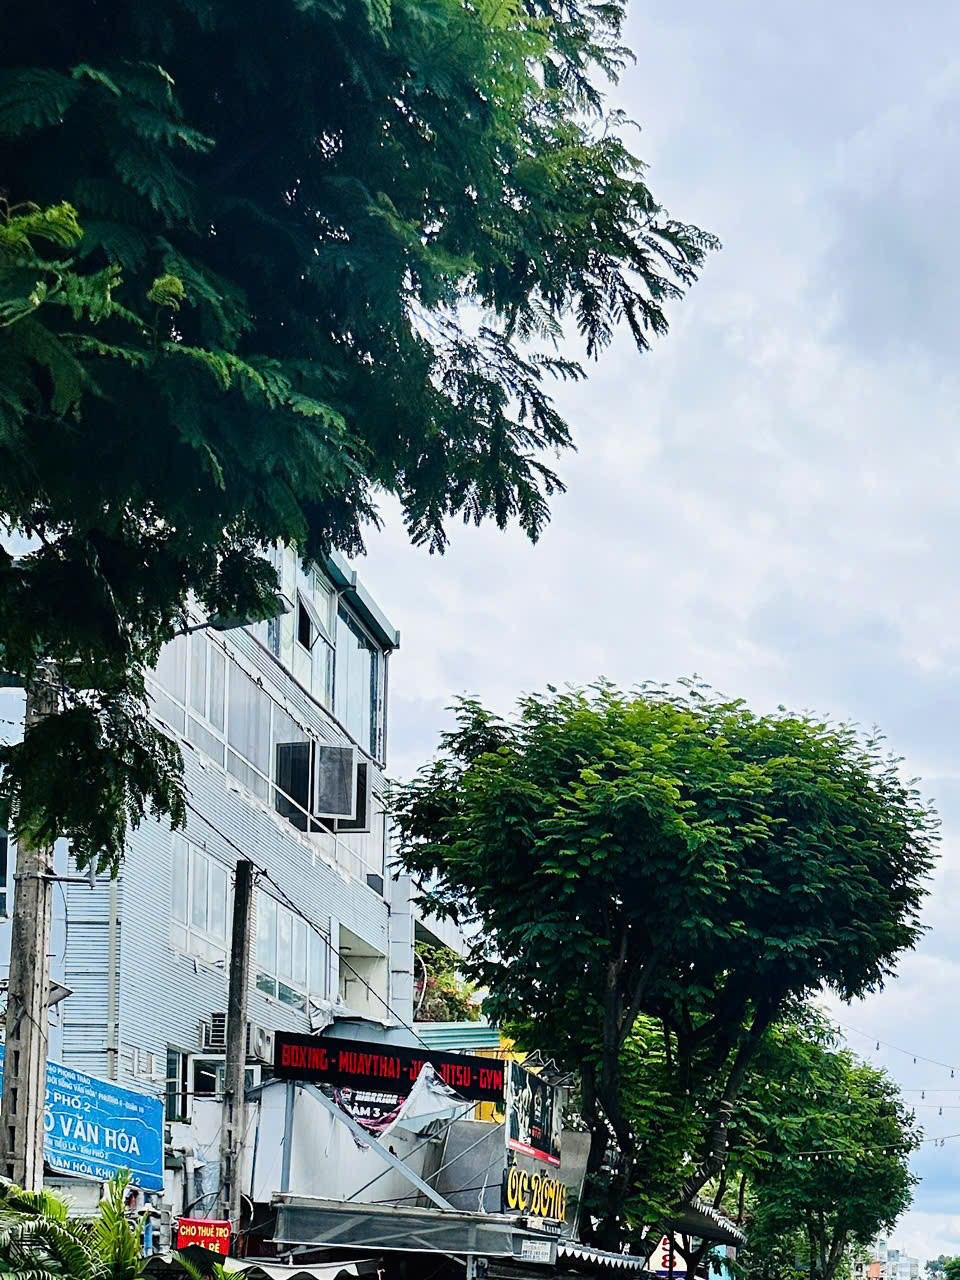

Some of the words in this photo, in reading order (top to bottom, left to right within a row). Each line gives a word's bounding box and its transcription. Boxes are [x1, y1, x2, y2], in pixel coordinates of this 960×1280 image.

[282, 1045, 328, 1070] BOXING
[339, 1050, 401, 1078] MUAYTHAI
[480, 1068, 503, 1090] GYM
[53, 1091, 82, 1110] PHỐ
[83, 1101, 92, 1113] 2
[60, 1113, 99, 1145] VĂN
[104, 1127, 140, 1156] HÓA
[73, 1161, 93, 1175] HÓA
[96, 1167, 115, 1180] KHU
[180, 1225, 197, 1236] CHO
[198, 1224, 215, 1237] THUÊ
